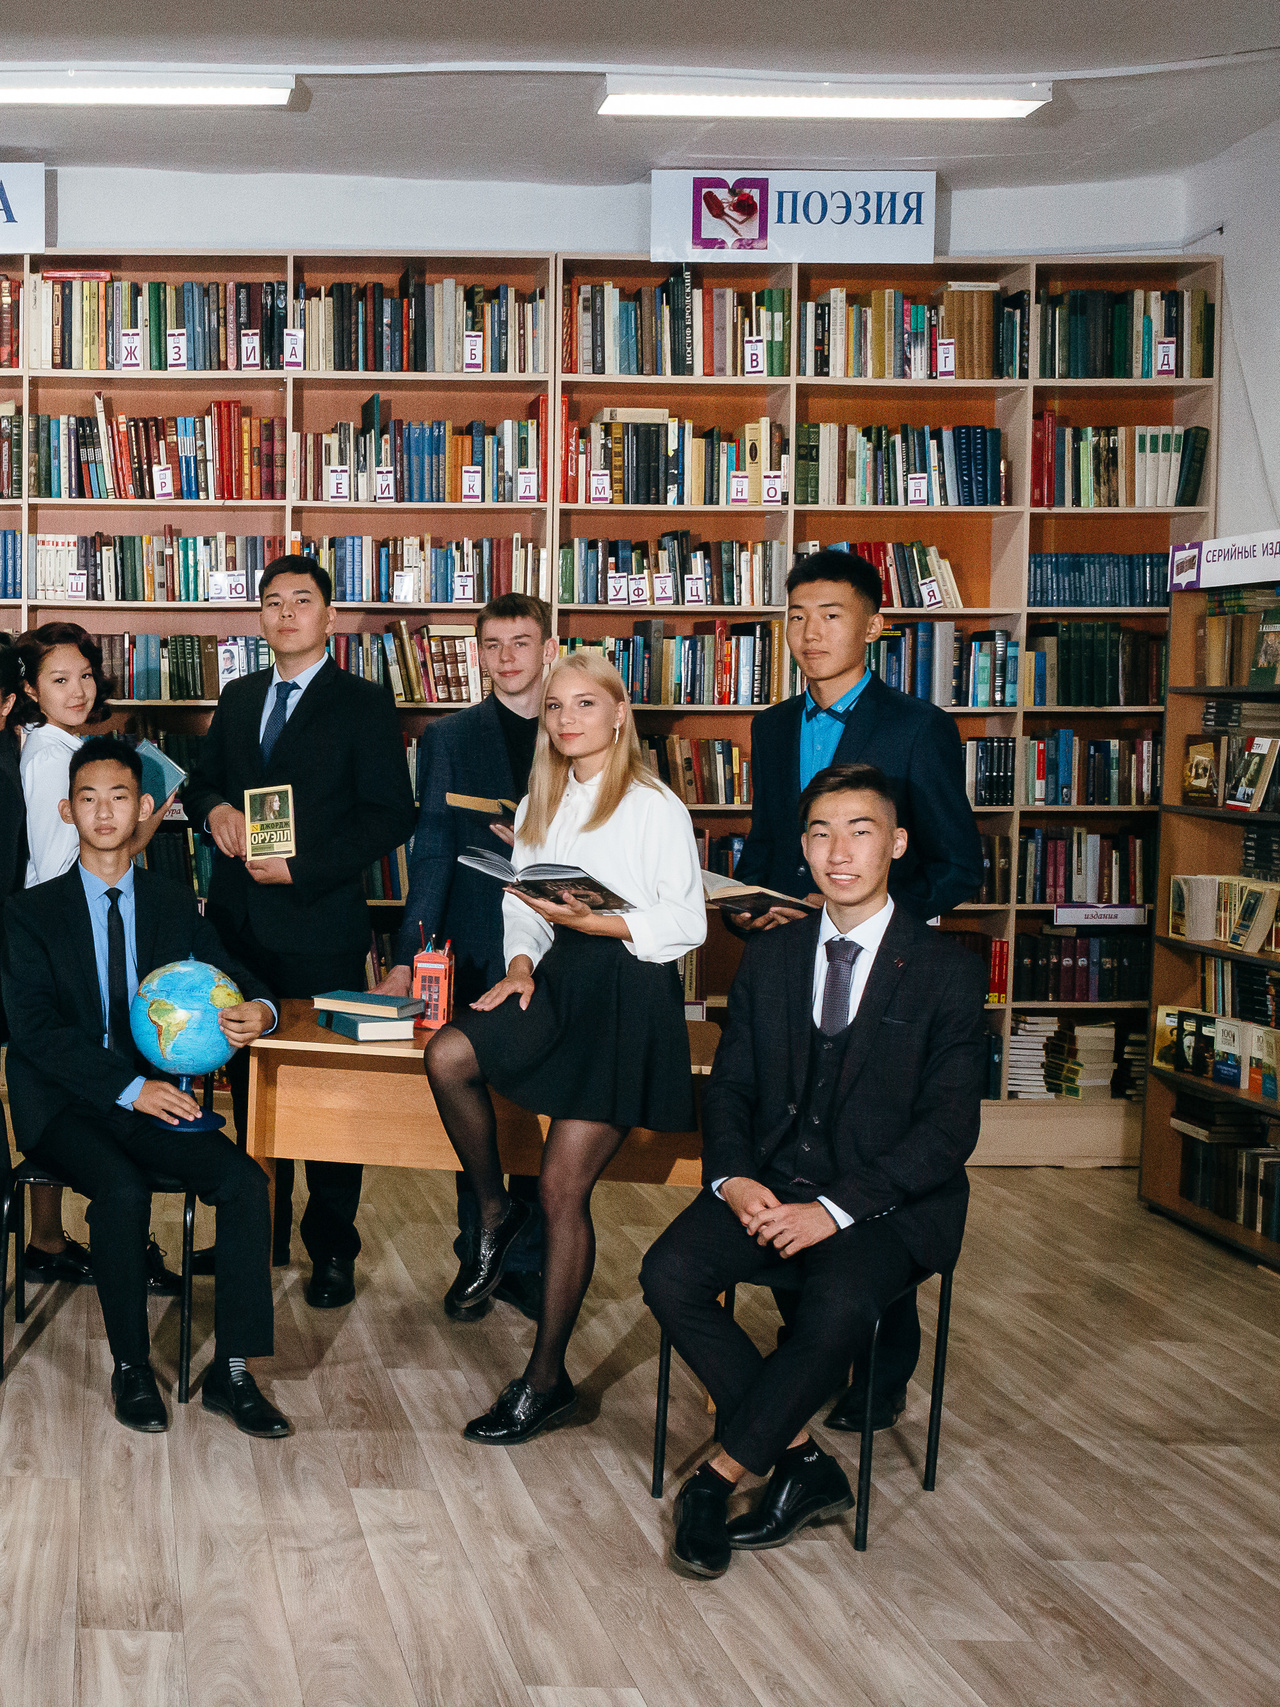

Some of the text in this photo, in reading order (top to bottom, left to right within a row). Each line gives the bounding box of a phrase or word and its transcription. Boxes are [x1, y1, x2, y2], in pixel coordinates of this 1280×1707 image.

[774, 190, 925, 226] ПОЭЗИЯ
[683, 271, 692, 325] БРОДСКИЙ
[124, 345, 138, 361] Ж
[172, 345, 182, 362] З
[245, 345, 256, 362] И
[289, 346, 298, 359] А
[469, 348, 477, 361] Б
[750, 352, 759, 369] В
[1160, 353, 1171, 369] Д
[160, 481, 167, 491] Р
[335, 482, 343, 495] Е
[380, 483, 391, 496] И
[468, 483, 475, 494] К
[522, 484, 531, 494] Л
[594, 485, 606, 496] М
[735, 487, 744, 497] Н
[766, 486, 778, 499] О
[913, 488, 922, 498] П
[1205, 543, 1258, 564] СЕРИЙНЫЕ
[70, 581, 84, 593] Ш
[229, 582, 245, 596] Ю
[459, 584, 469, 597] Т
[612, 585, 623, 597] У
[632, 586, 645, 599] Ф
[690, 586, 700, 600] Ц
[927, 589, 937, 603] Я
[165, 807, 182, 818] ура
[259, 821, 291, 831] ДЖОРДЖ
[251, 829, 292, 845] ОРУЭЛЛ
[1083, 911, 1119, 921] издания
